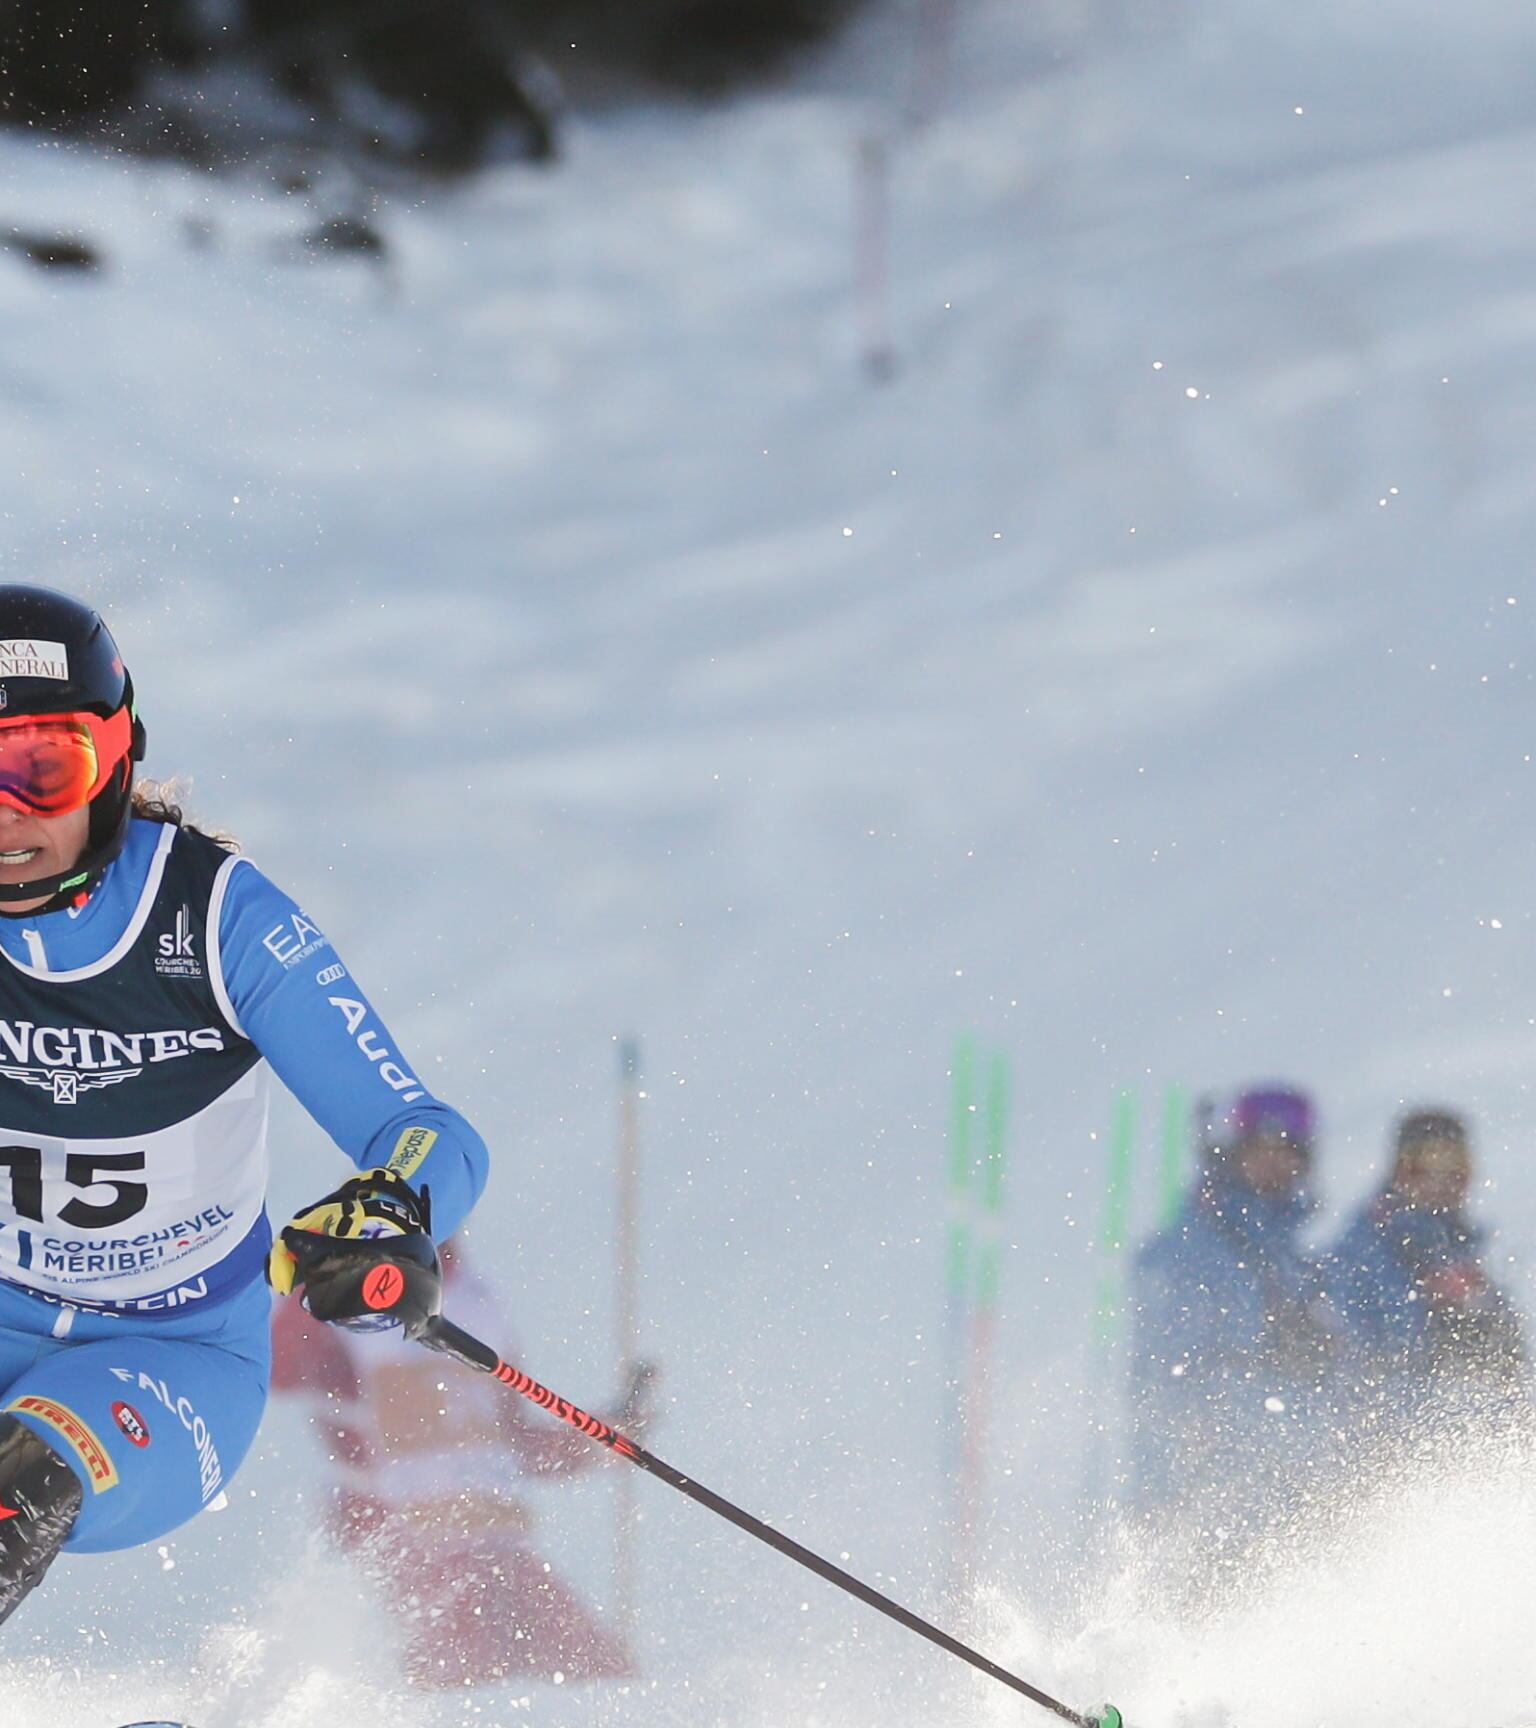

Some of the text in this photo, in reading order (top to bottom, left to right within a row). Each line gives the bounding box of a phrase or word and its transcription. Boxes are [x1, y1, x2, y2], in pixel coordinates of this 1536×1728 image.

[262, 906, 322, 963] EA
[328, 996, 425, 1103] Audi
[42, 1205, 234, 1254] COURCHEVEL
[18, 1397, 111, 1480] PIRELLI
[109, 1367, 224, 1504] FALCONERI
